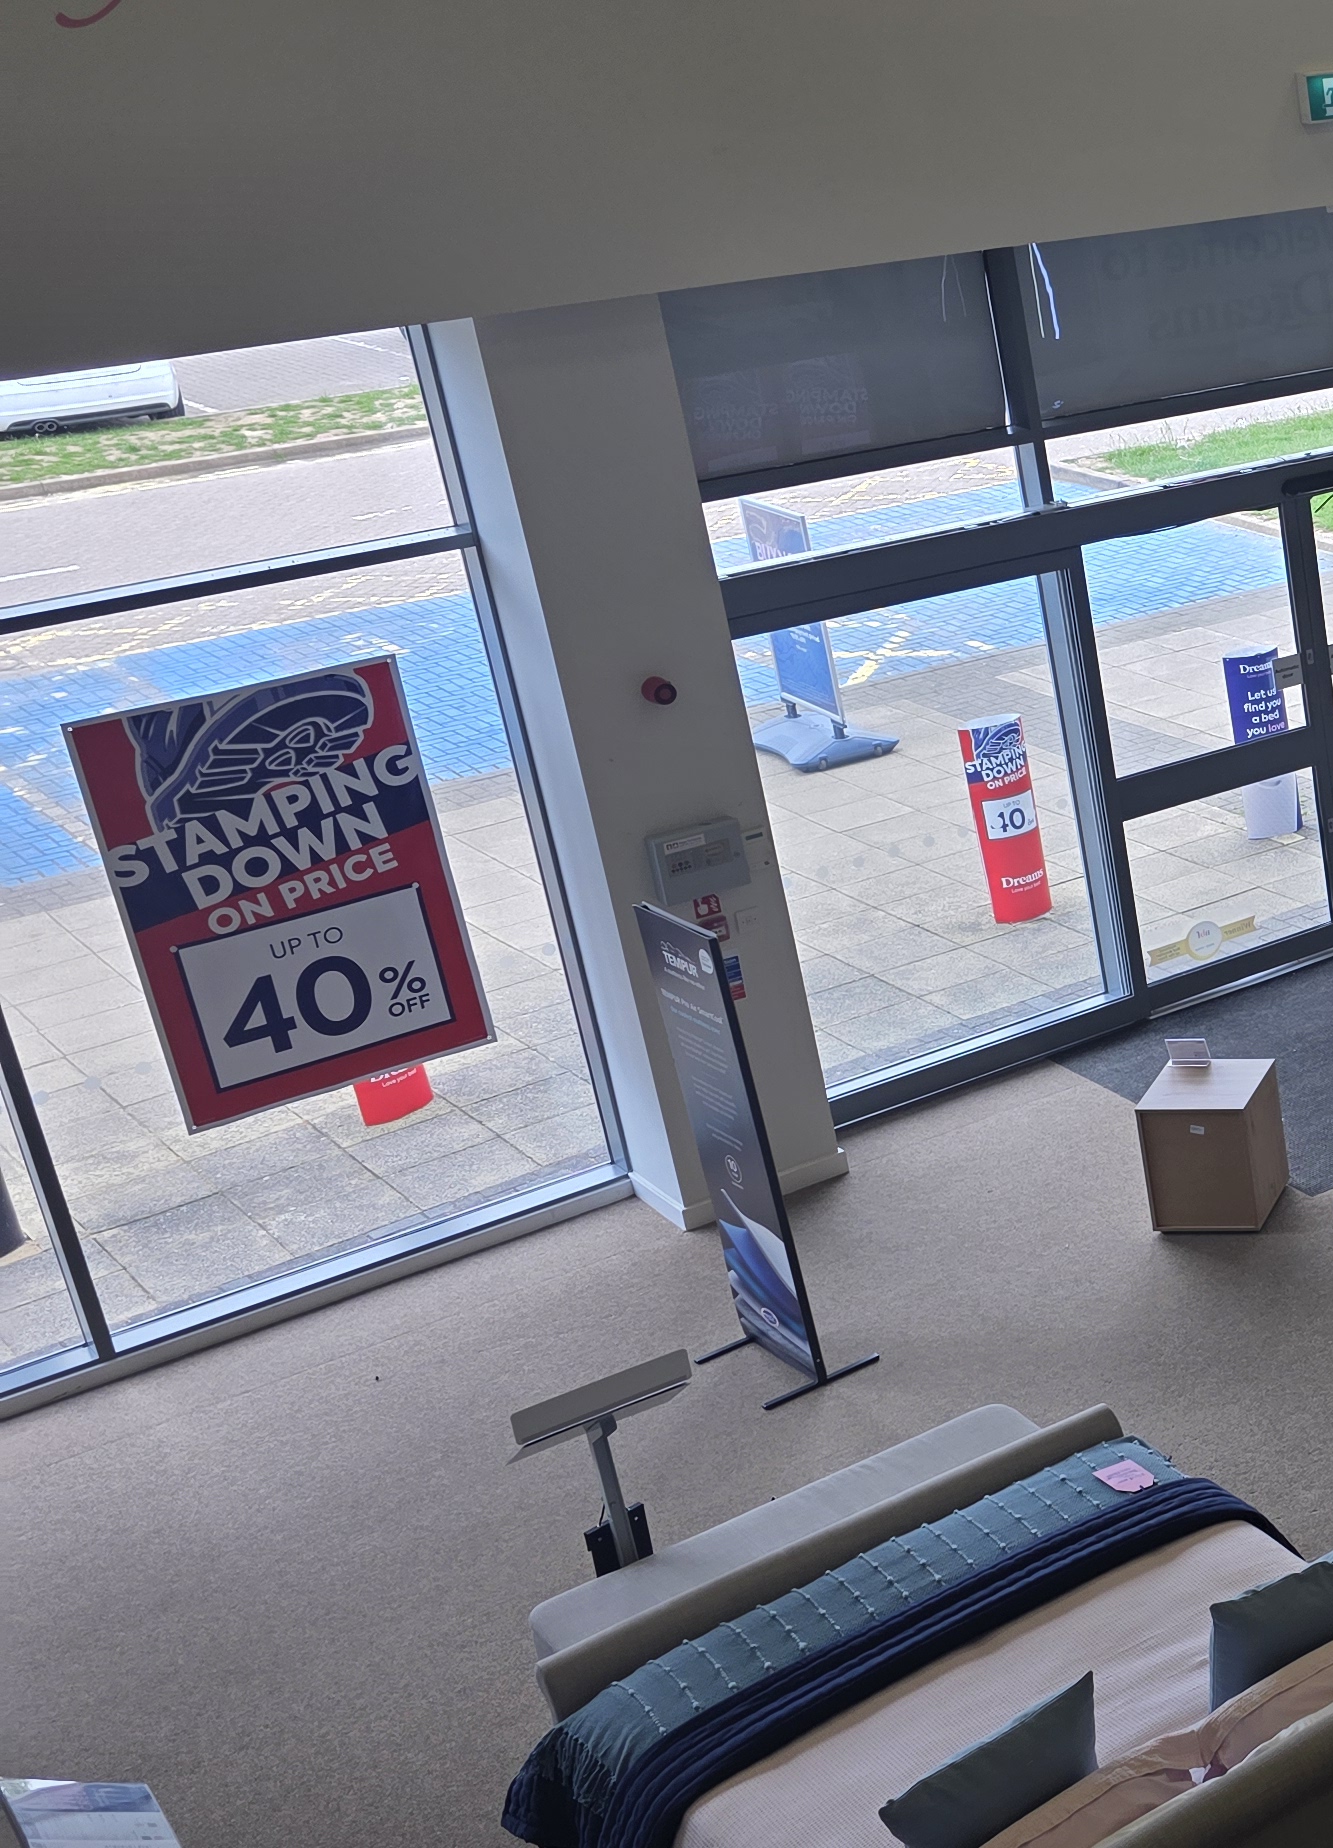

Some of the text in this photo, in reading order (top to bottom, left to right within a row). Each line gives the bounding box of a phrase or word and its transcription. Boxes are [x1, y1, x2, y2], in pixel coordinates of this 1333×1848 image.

[1243, 698, 1282, 713] find you
[1247, 689, 1266, 700] Let
[1262, 710, 1279, 722] bed
[1247, 721, 1285, 738] you love
[981, 756, 1025, 782] DOWN
[986, 779, 1003, 790] ON
[107, 743, 419, 889] STAMPING
[179, 800, 389, 910] DOWN
[207, 844, 398, 936] ON PRICE
[1001, 868, 1044, 888] Dreams
[269, 926, 344, 961] UP TO
[662, 951, 699, 978] TEMPUR
[387, 993, 432, 1018] OFF
